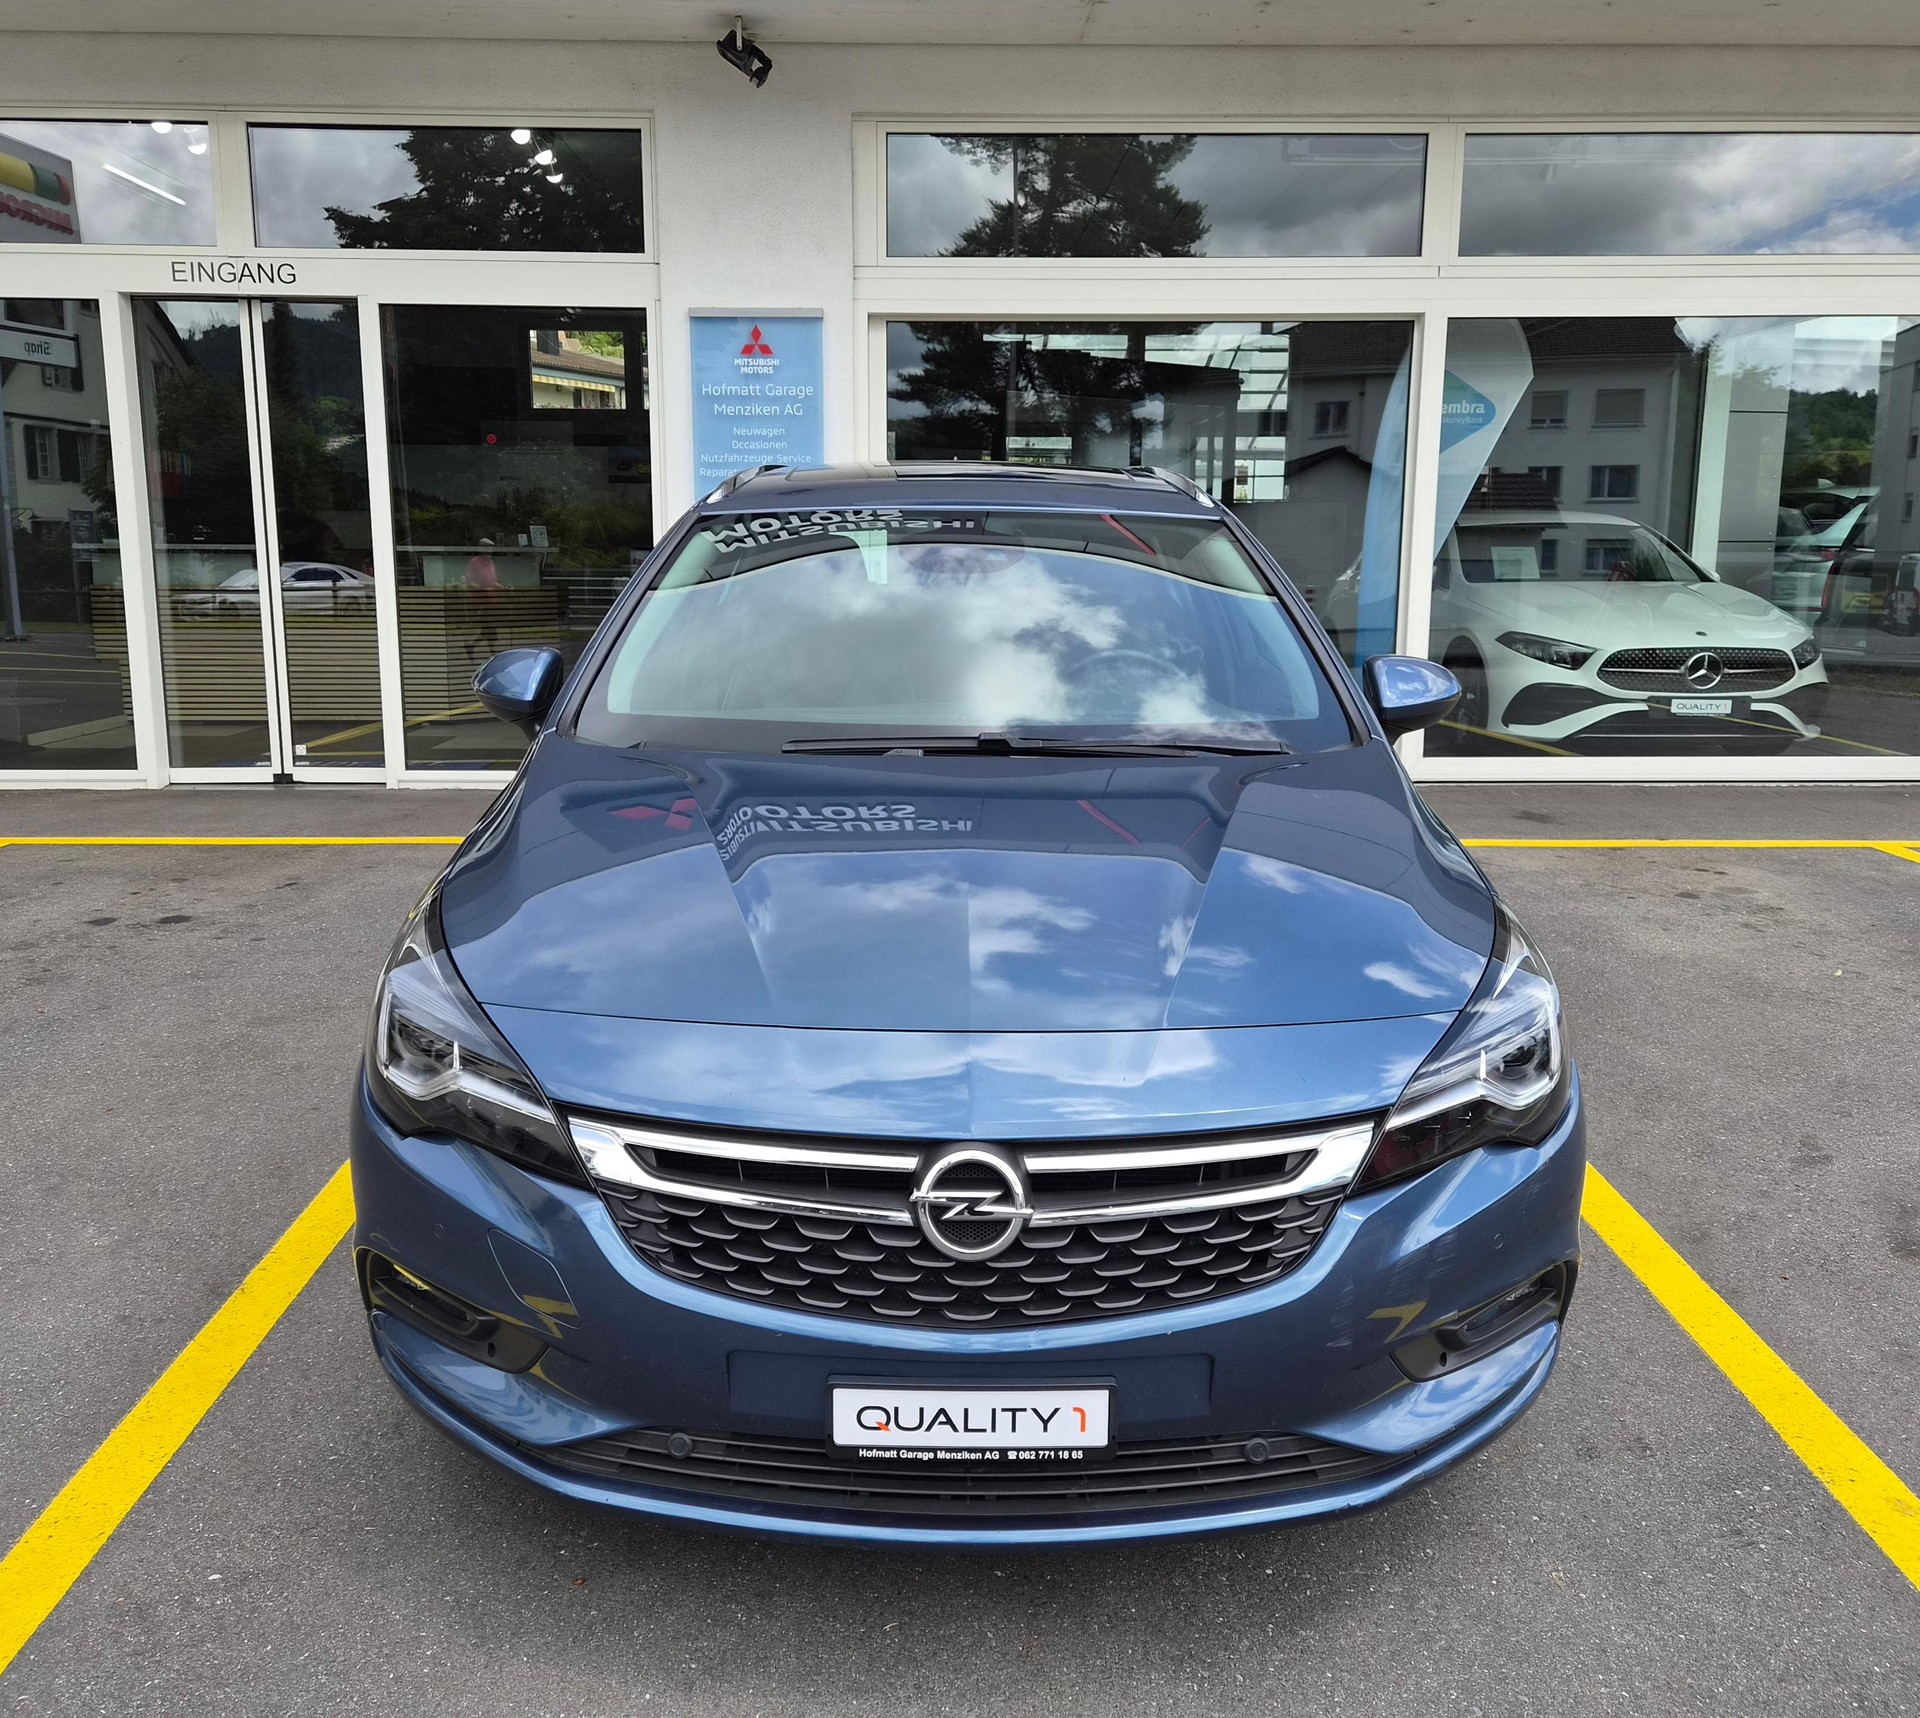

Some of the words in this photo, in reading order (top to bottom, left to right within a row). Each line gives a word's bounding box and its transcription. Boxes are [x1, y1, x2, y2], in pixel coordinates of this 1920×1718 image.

[171, 261, 297, 284] EINGANG
[734, 358, 780, 366] MITSUBISHI
[740, 366, 774, 374] MOTORS
[702, 383, 762, 396] Hofmatt
[765, 383, 814, 398] Garage
[714, 403, 780, 416] Menziken
[784, 403, 803, 416] AG
[1441, 400, 1486, 414] embra
[733, 427, 786, 438] Neuwagen
[732, 440, 788, 449] Occasionen
[700, 453, 773, 465] Nutzfahrzeuge
[776, 453, 812, 463] Service
[699, 467, 738, 478] Reparat
[1676, 703, 1721, 711] QUALITY
[856, 1405, 1062, 1433] QUALITY
[1072, 1406, 1087, 1433] 1
[859, 1448, 897, 1459] Hofmatt
[899, 1449, 935, 1461] Garage
[937, 1450, 983, 1460] Menziken
[984, 1450, 1000, 1460] AG
[1018, 1451, 1037, 1460] 062
[1038, 1451, 1056, 1460] 771
[1057, 1451, 1070, 1460] 18
[1071, 1451, 1084, 1460] 65
